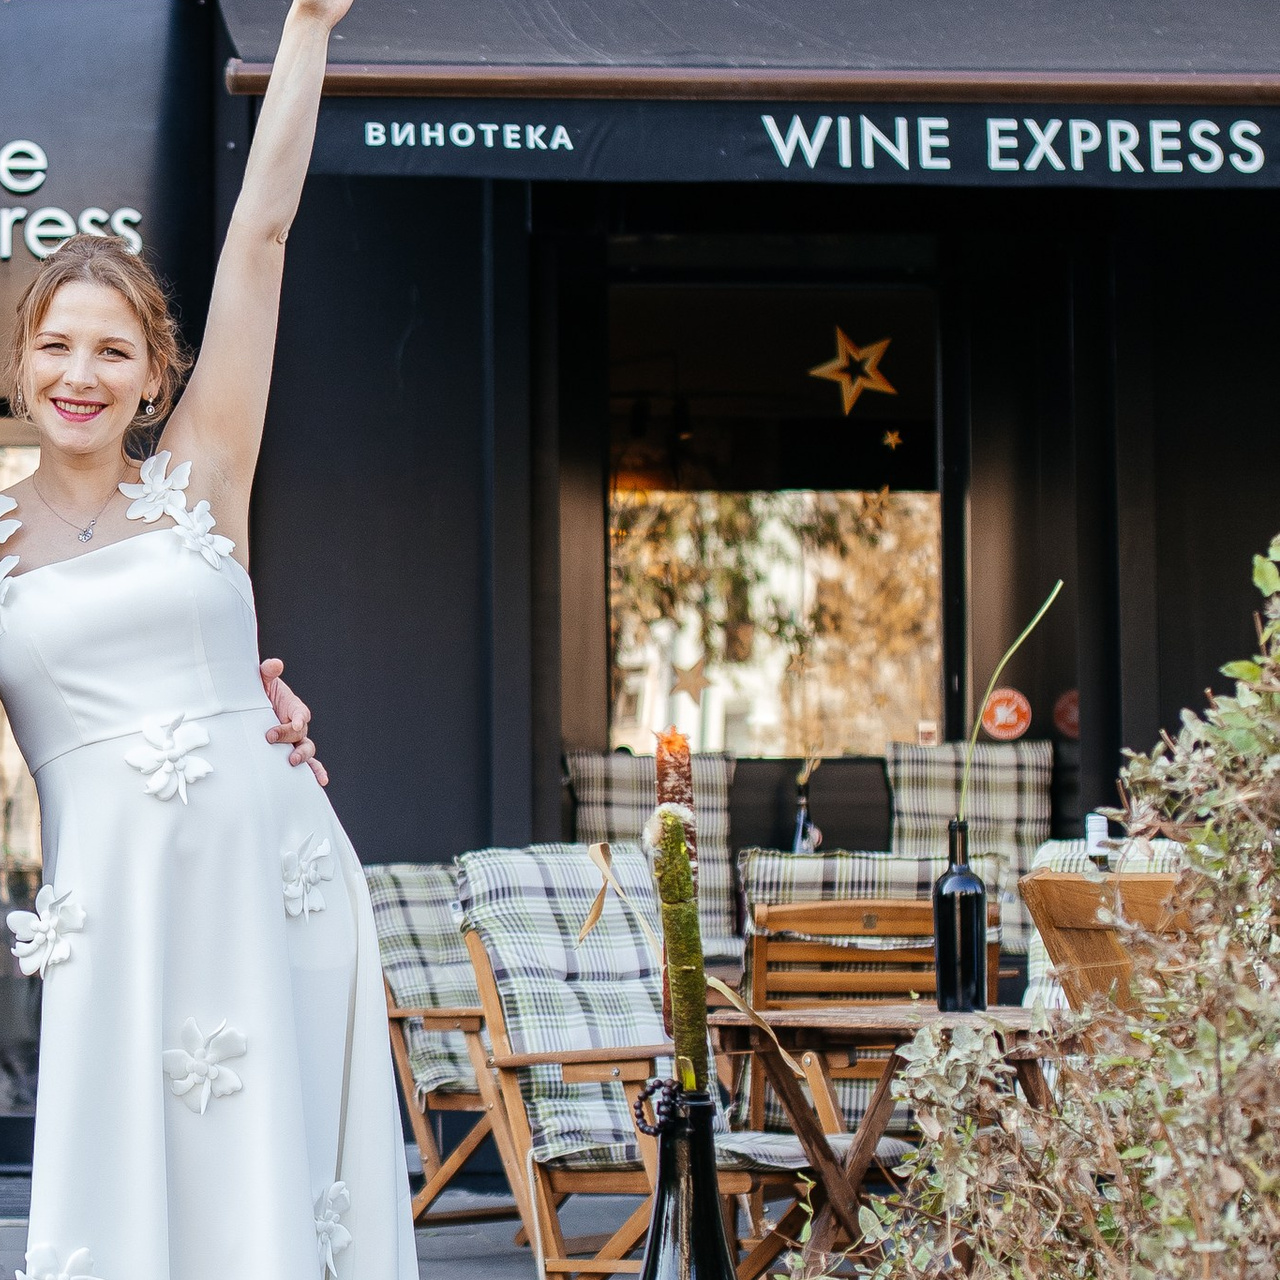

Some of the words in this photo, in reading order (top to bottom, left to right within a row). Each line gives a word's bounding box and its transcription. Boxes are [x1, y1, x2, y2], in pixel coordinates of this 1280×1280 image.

[364, 122, 574, 150] ВИНОТЕКА
[760, 115, 951, 170] WINE
[987, 118, 1265, 173] EXPRESS
